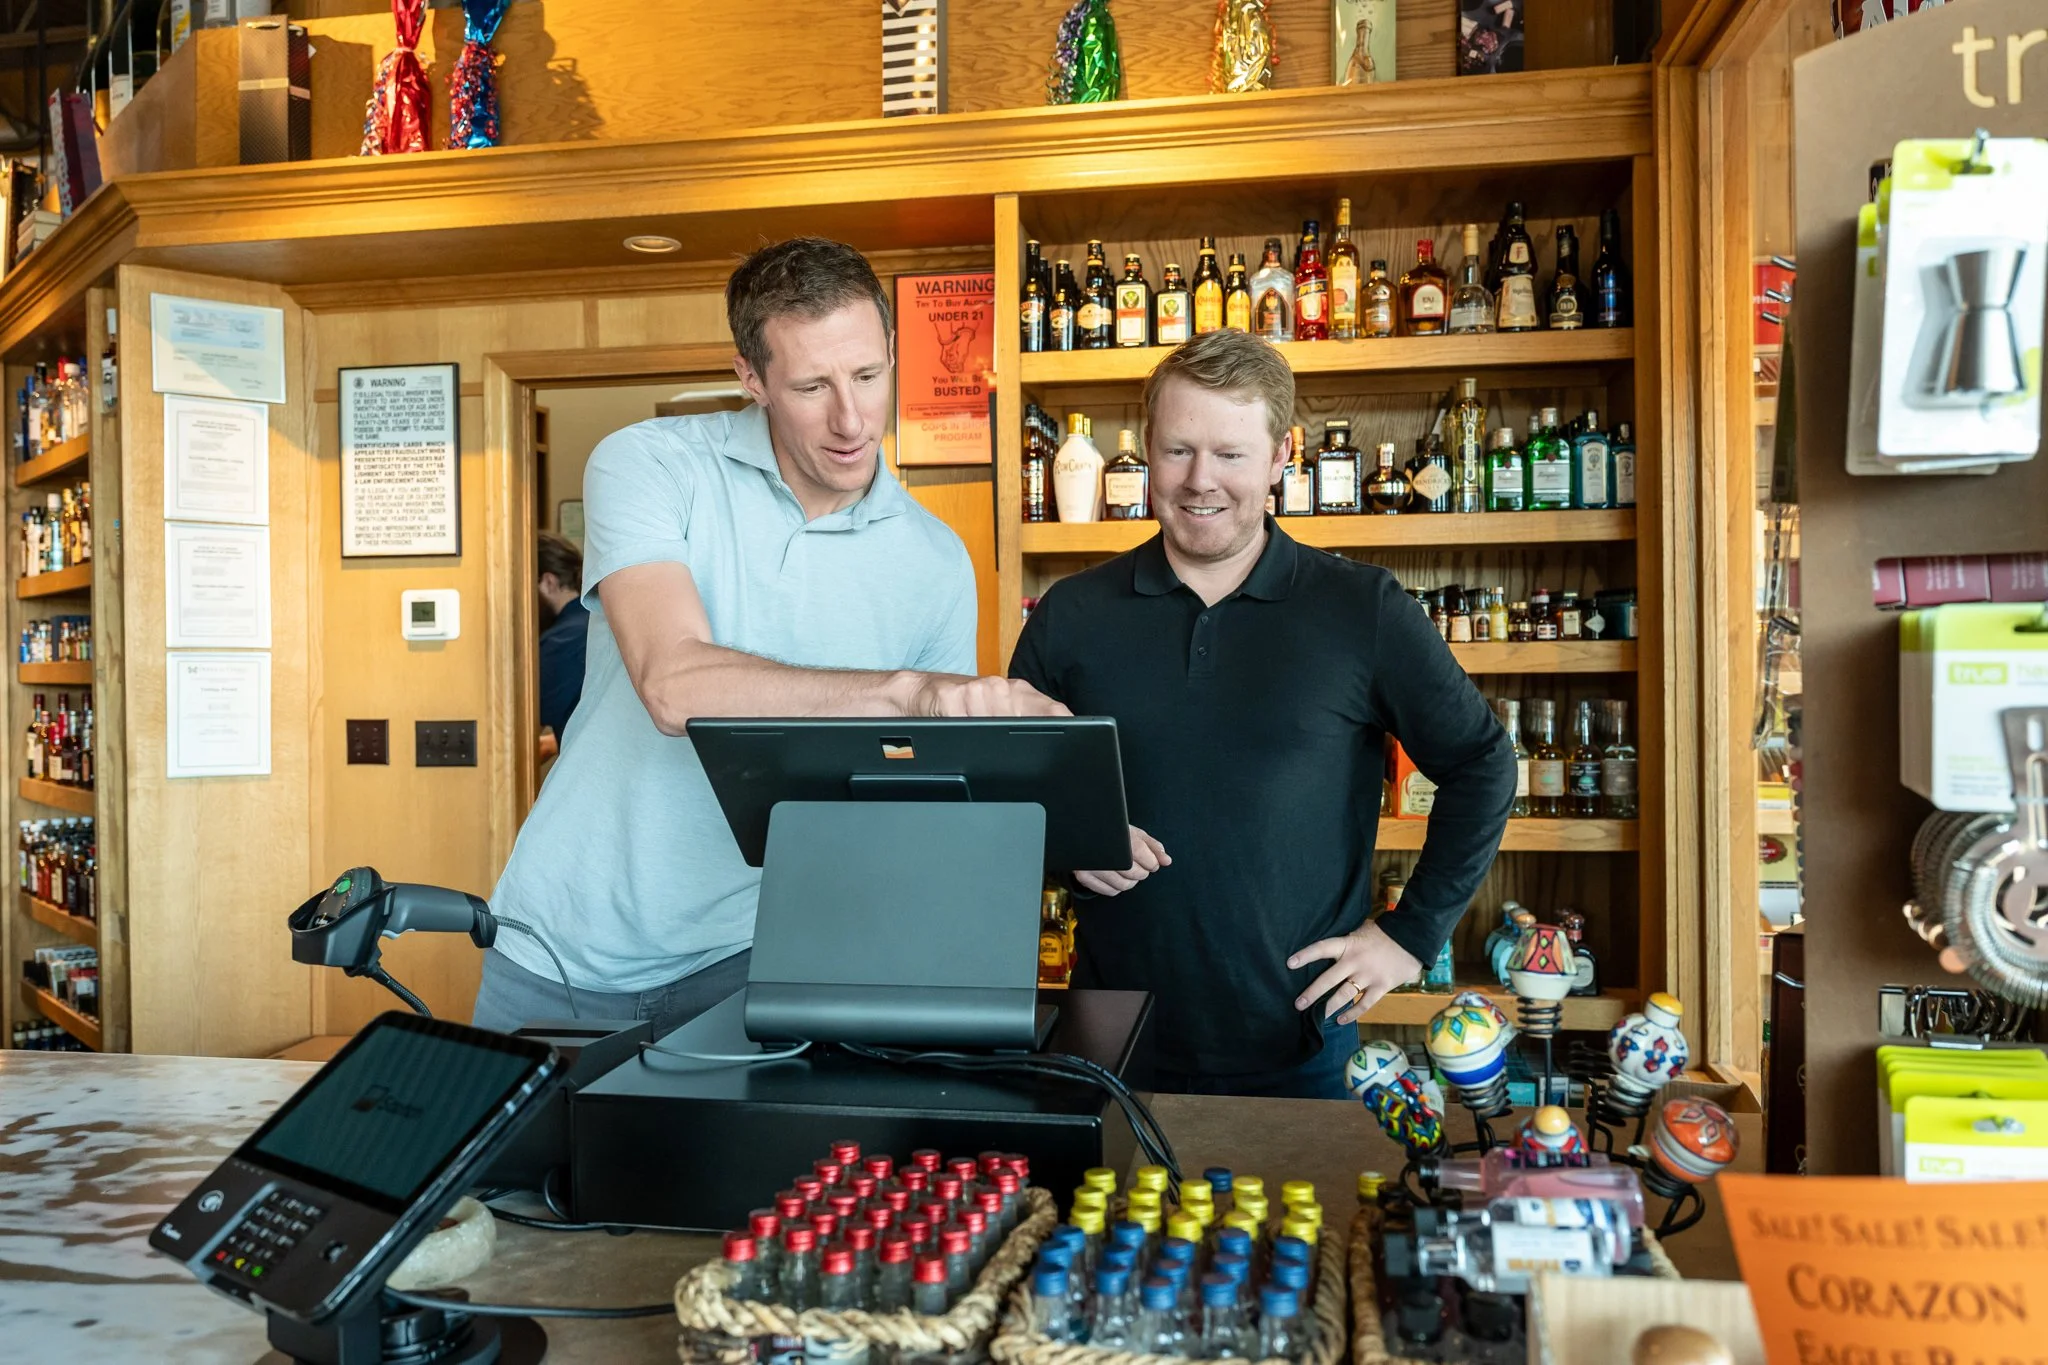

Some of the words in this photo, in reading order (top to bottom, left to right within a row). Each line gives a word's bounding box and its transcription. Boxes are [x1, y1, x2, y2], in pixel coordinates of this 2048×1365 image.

[916, 278, 994, 294] WARNING
[928, 311, 968, 322] UNDER
[972, 310, 984, 320] 21
[934, 385, 981, 397] BUSTED
[1954, 664, 2003, 679] true
[1830, 1213, 1924, 1246] SALE!
[1787, 1262, 2029, 1326] CORAZON
